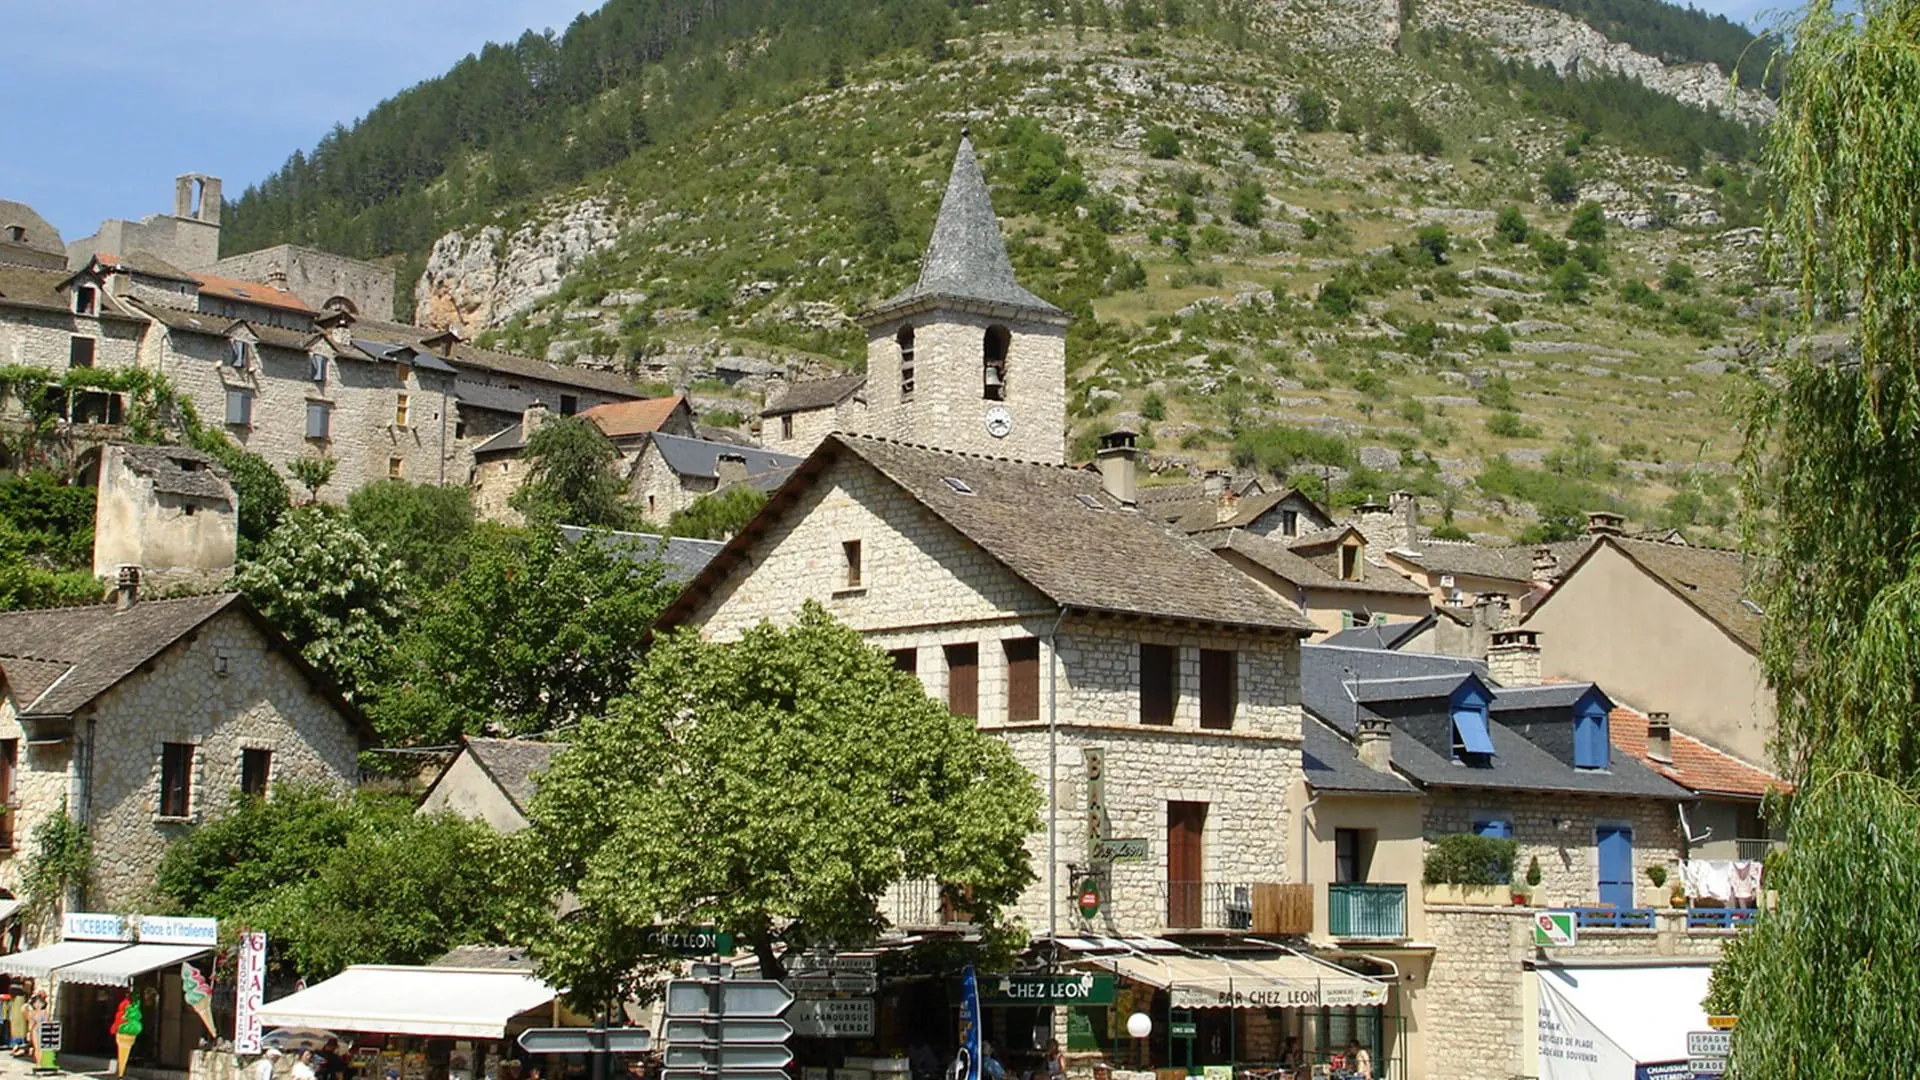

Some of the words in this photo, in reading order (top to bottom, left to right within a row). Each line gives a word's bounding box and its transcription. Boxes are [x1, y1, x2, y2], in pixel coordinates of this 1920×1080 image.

[1088, 753, 1101, 839] BAR
[70, 917, 122, 936] L'ICEBERG
[140, 920, 165, 935] Glace
[647, 932, 679, 948] CHEZ
[681, 932, 717, 949] LEON
[247, 934, 264, 1052] GLACES
[1007, 983, 1046, 998] CHEZ
[1050, 983, 1089, 998] LEON
[1218, 991, 1243, 1005] BAR
[1249, 990, 1281, 1005] CHEZ
[1288, 990, 1319, 1005] LEON
[829, 1003, 870, 1012] CHANAC
[800, 1013, 811, 1022] LA
[834, 1023, 870, 1032] MENDE
[1691, 1035, 1733, 1044] ISPAGN
[1691, 1043, 1729, 1052] FLORAC
[1691, 1062, 1724, 1070] PRADE
